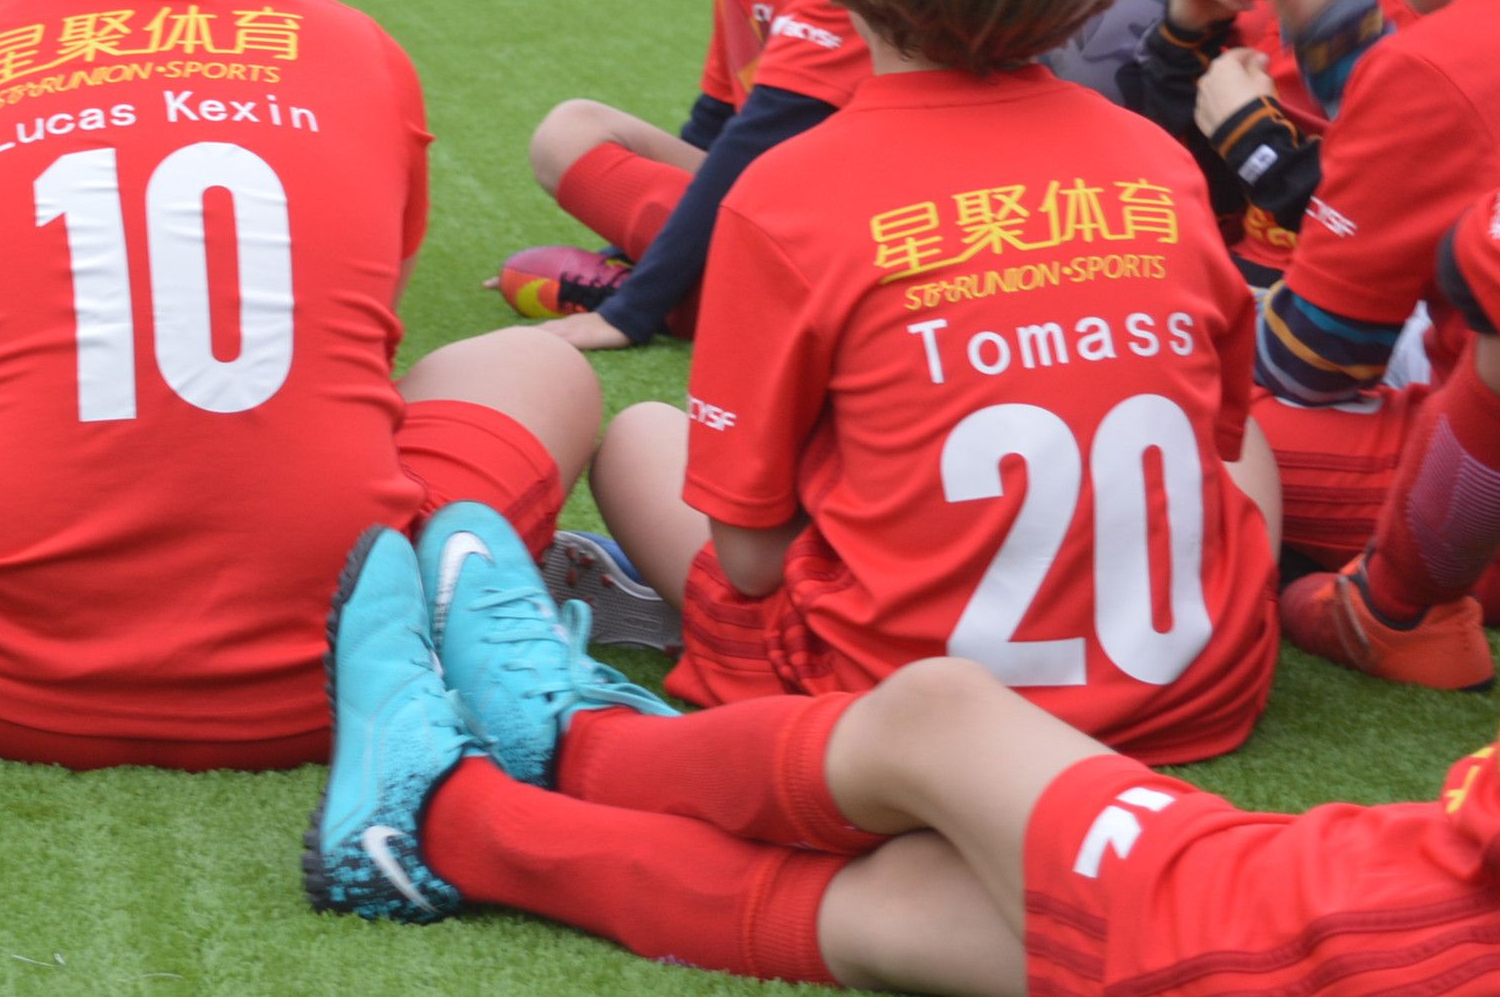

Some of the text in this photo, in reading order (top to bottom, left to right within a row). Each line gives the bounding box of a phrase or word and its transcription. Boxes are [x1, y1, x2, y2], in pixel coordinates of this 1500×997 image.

[163, 90, 321, 133] Kexin
[33, 141, 296, 423] 10
[869, 178, 1180, 284] 星聚体育
[906, 311, 1195, 385] Tomass
[940, 393, 1214, 688] 20
